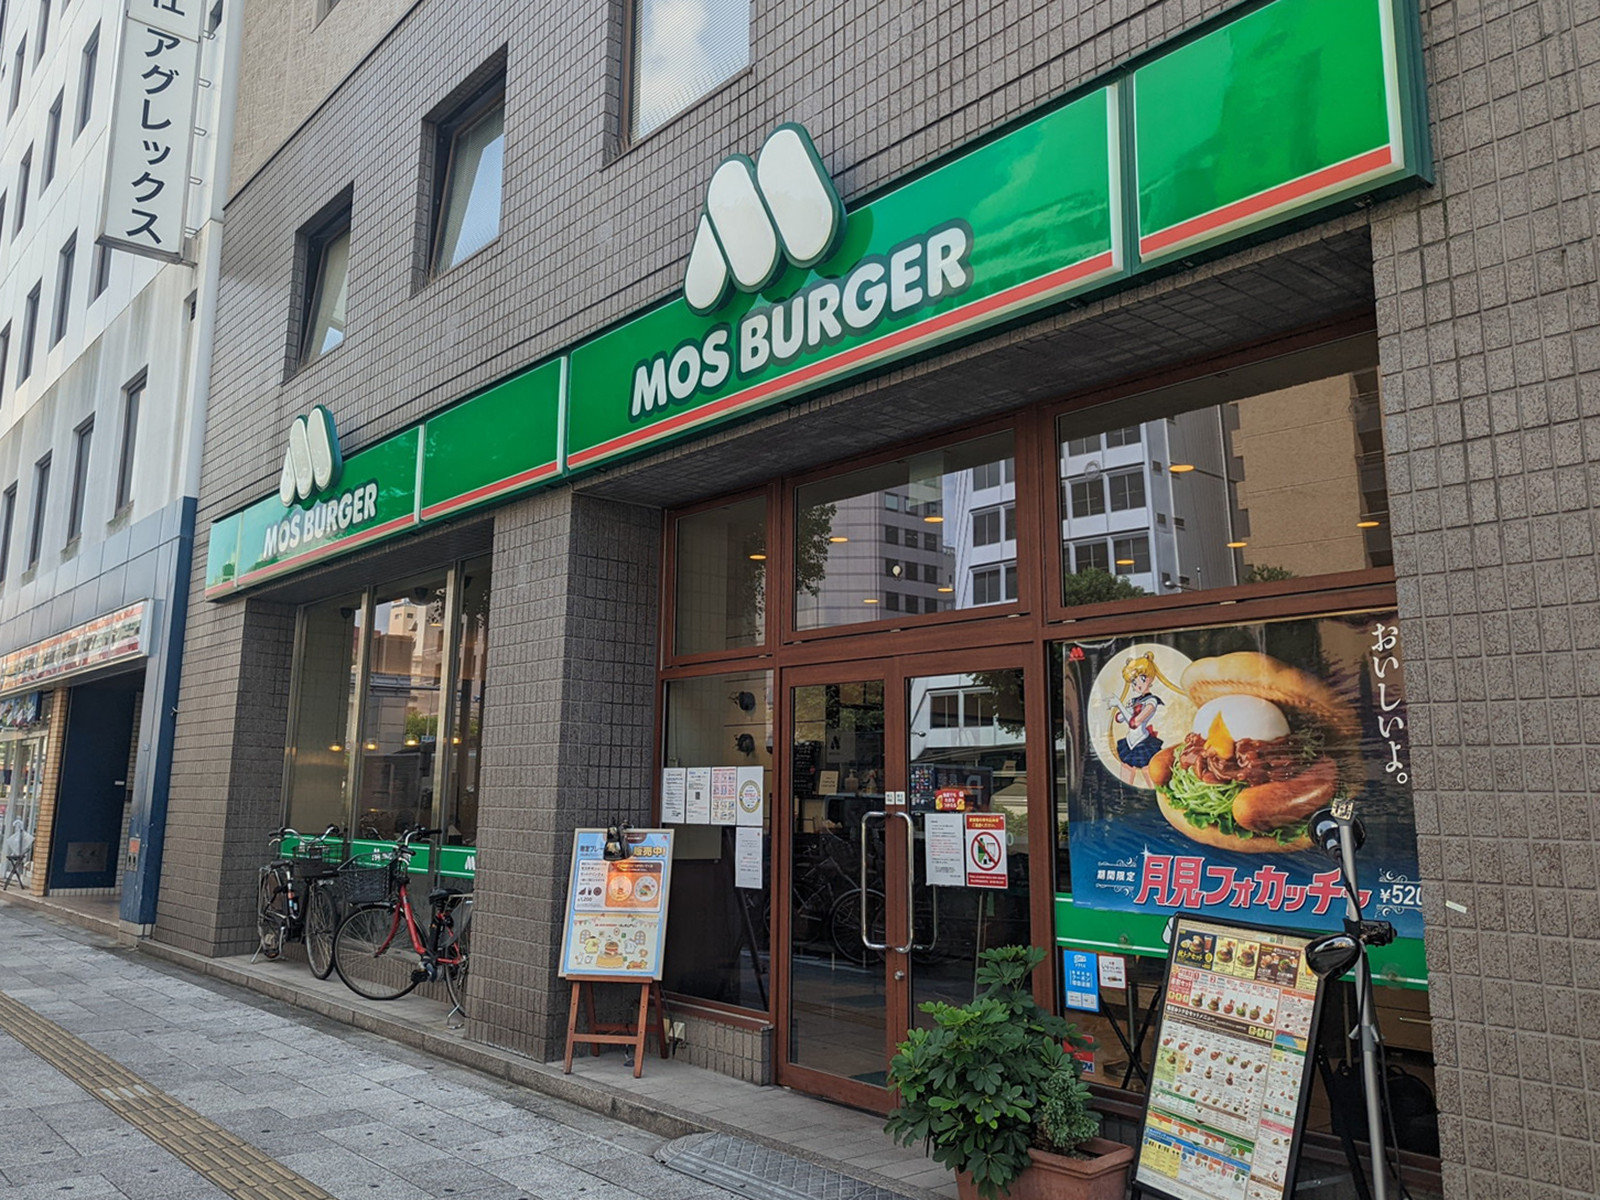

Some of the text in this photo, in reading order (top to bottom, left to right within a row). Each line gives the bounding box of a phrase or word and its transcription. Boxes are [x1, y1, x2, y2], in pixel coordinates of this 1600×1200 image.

[631, 226, 967, 417] MOS BURGER
[263, 482, 378, 559] MOS BURGER
[1371, 622, 1408, 784] おいしいよ。
[1096, 869, 1136, 882] 期間限定
